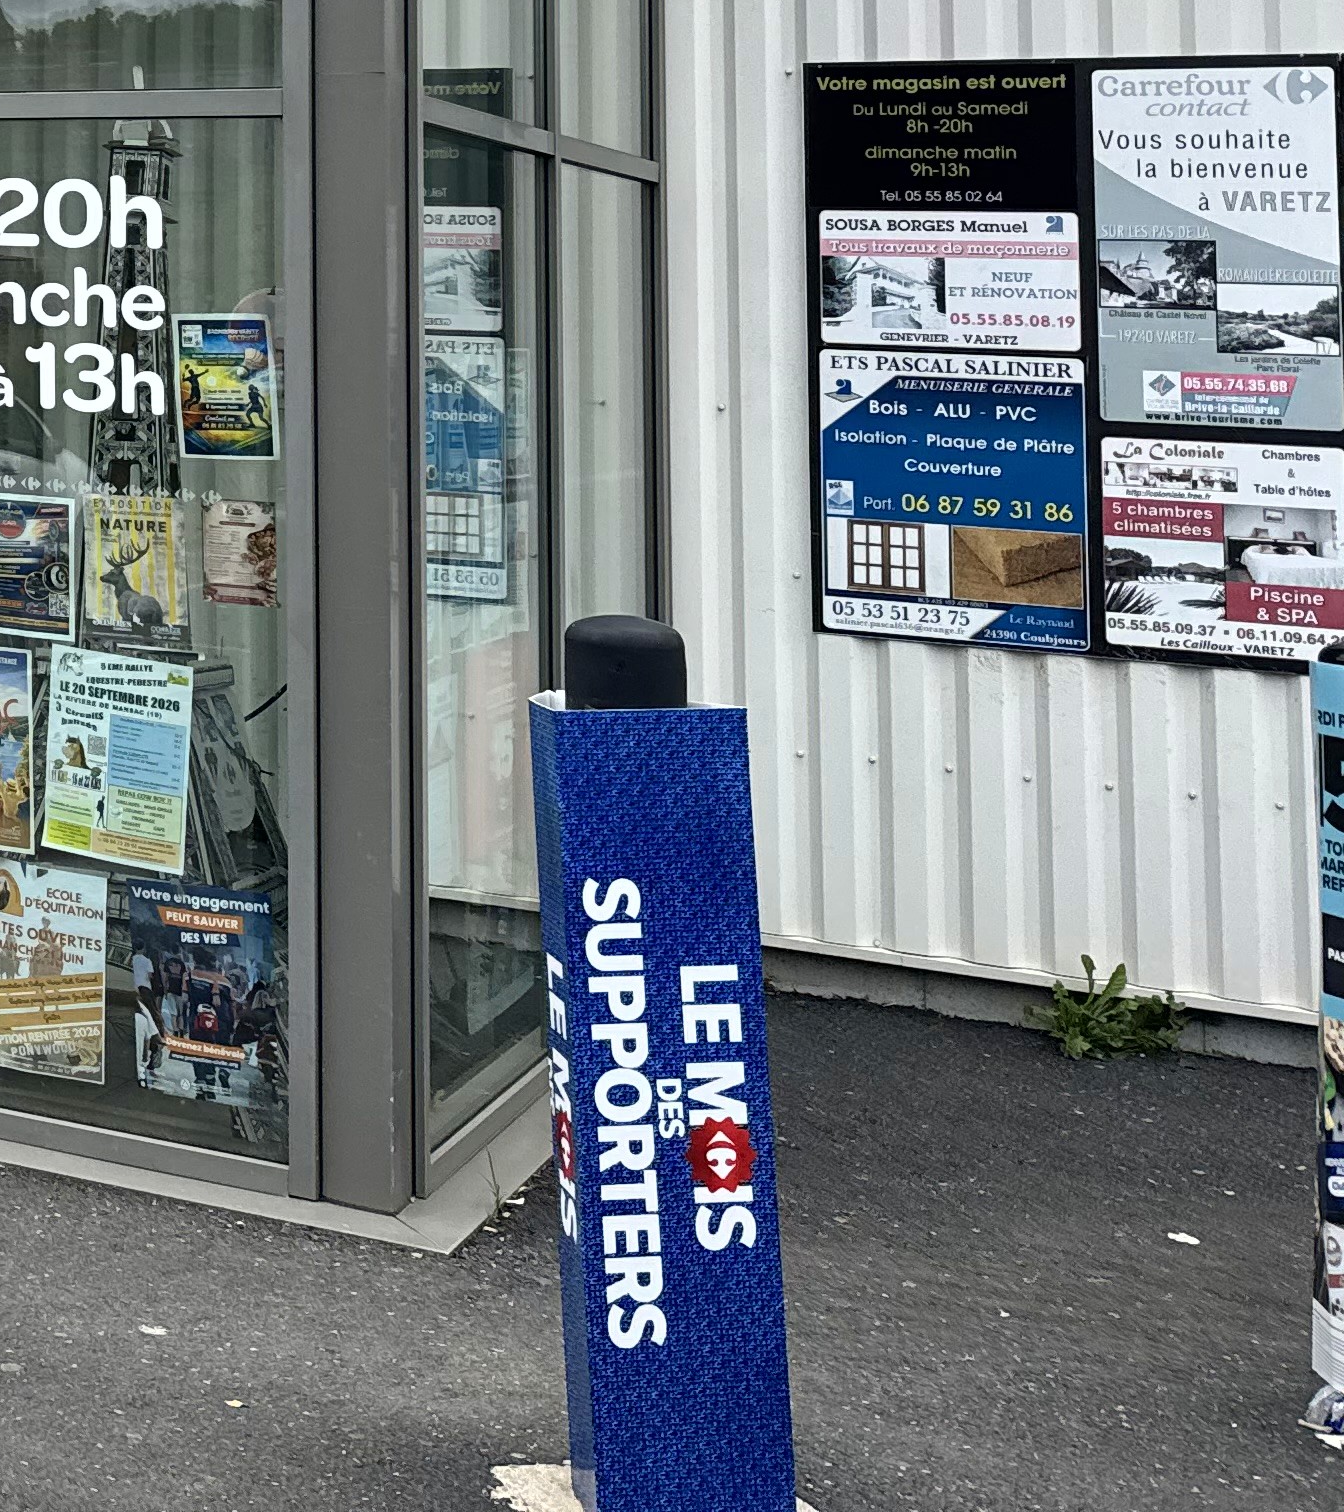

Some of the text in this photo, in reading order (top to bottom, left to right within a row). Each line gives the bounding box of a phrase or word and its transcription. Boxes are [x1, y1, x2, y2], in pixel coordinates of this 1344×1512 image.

[816, 74, 1066, 93] Votre magasin est ouvert
[1098, 74, 1251, 97] Carrefour
[879, 101, 1028, 116] Lundi Samedi
[1145, 99, 1251, 117] contact
[1098, 129, 1291, 150] Vous souhaite
[865, 146, 1017, 159] dimanche matin
[1137, 158, 1308, 178] la bienvenue
[1222, 191, 1331, 212] VARETZ
[826, 218, 1028, 233] SOUSA BORGES Manuel
[829, 240, 1069, 258] Tous travaux maçonnerie
[991, 271, 1033, 283] NEUF
[971, 285, 1077, 299] RÉNOVATION
[830, 356, 1073, 378] ETS PASCAL SALINIER
[25, 342, 165, 415] 13h
[894, 379, 1073, 397] MENUISERIE GENERALE
[869, 400, 1037, 422] Bois ALU PVC
[835, 429, 1075, 455] Isolation Plaque de Plâtre
[1149, 442, 1225, 460] Coloniale
[1261, 449, 1321, 462] Chambres
[904, 459, 1002, 477] Couverture
[1253, 484, 1285, 496] Table
[93, 498, 172, 511] EXPOSITION
[901, 494, 1074, 522] 06 87 59 31 86
[1112, 502, 1213, 520] 5 chambres
[100, 518, 167, 533] NATURE
[1114, 519, 1212, 537] climatisées
[1250, 587, 1325, 606] Piscine
[832, 600, 971, 627] 05 53 51 23 75
[1277, 608, 1318, 624] SPA
[1108, 618, 1216, 637] 05.55.85.09.37
[983, 628, 1087, 649] 24390 Coubjours
[1244, 644, 1295, 657] VARETZ
[72, 683, 180, 712] 20 SEPTEMBRE 2026
[46, 888, 82, 903] ECOLE
[132, 886, 270, 914] Votre engagement
[25, 896, 103, 920] D'EQUITATION
[166, 911, 239, 930] PEUT SAUVER
[27, 928, 102, 952] OUVERTES
[181, 932, 228, 945] DES VIES
[679, 965, 741, 1044] LE
[73, 1027, 100, 1037] 2026
[582, 876, 667, 1350] SUPPORTERS
[653, 1078, 685, 1139] DES
